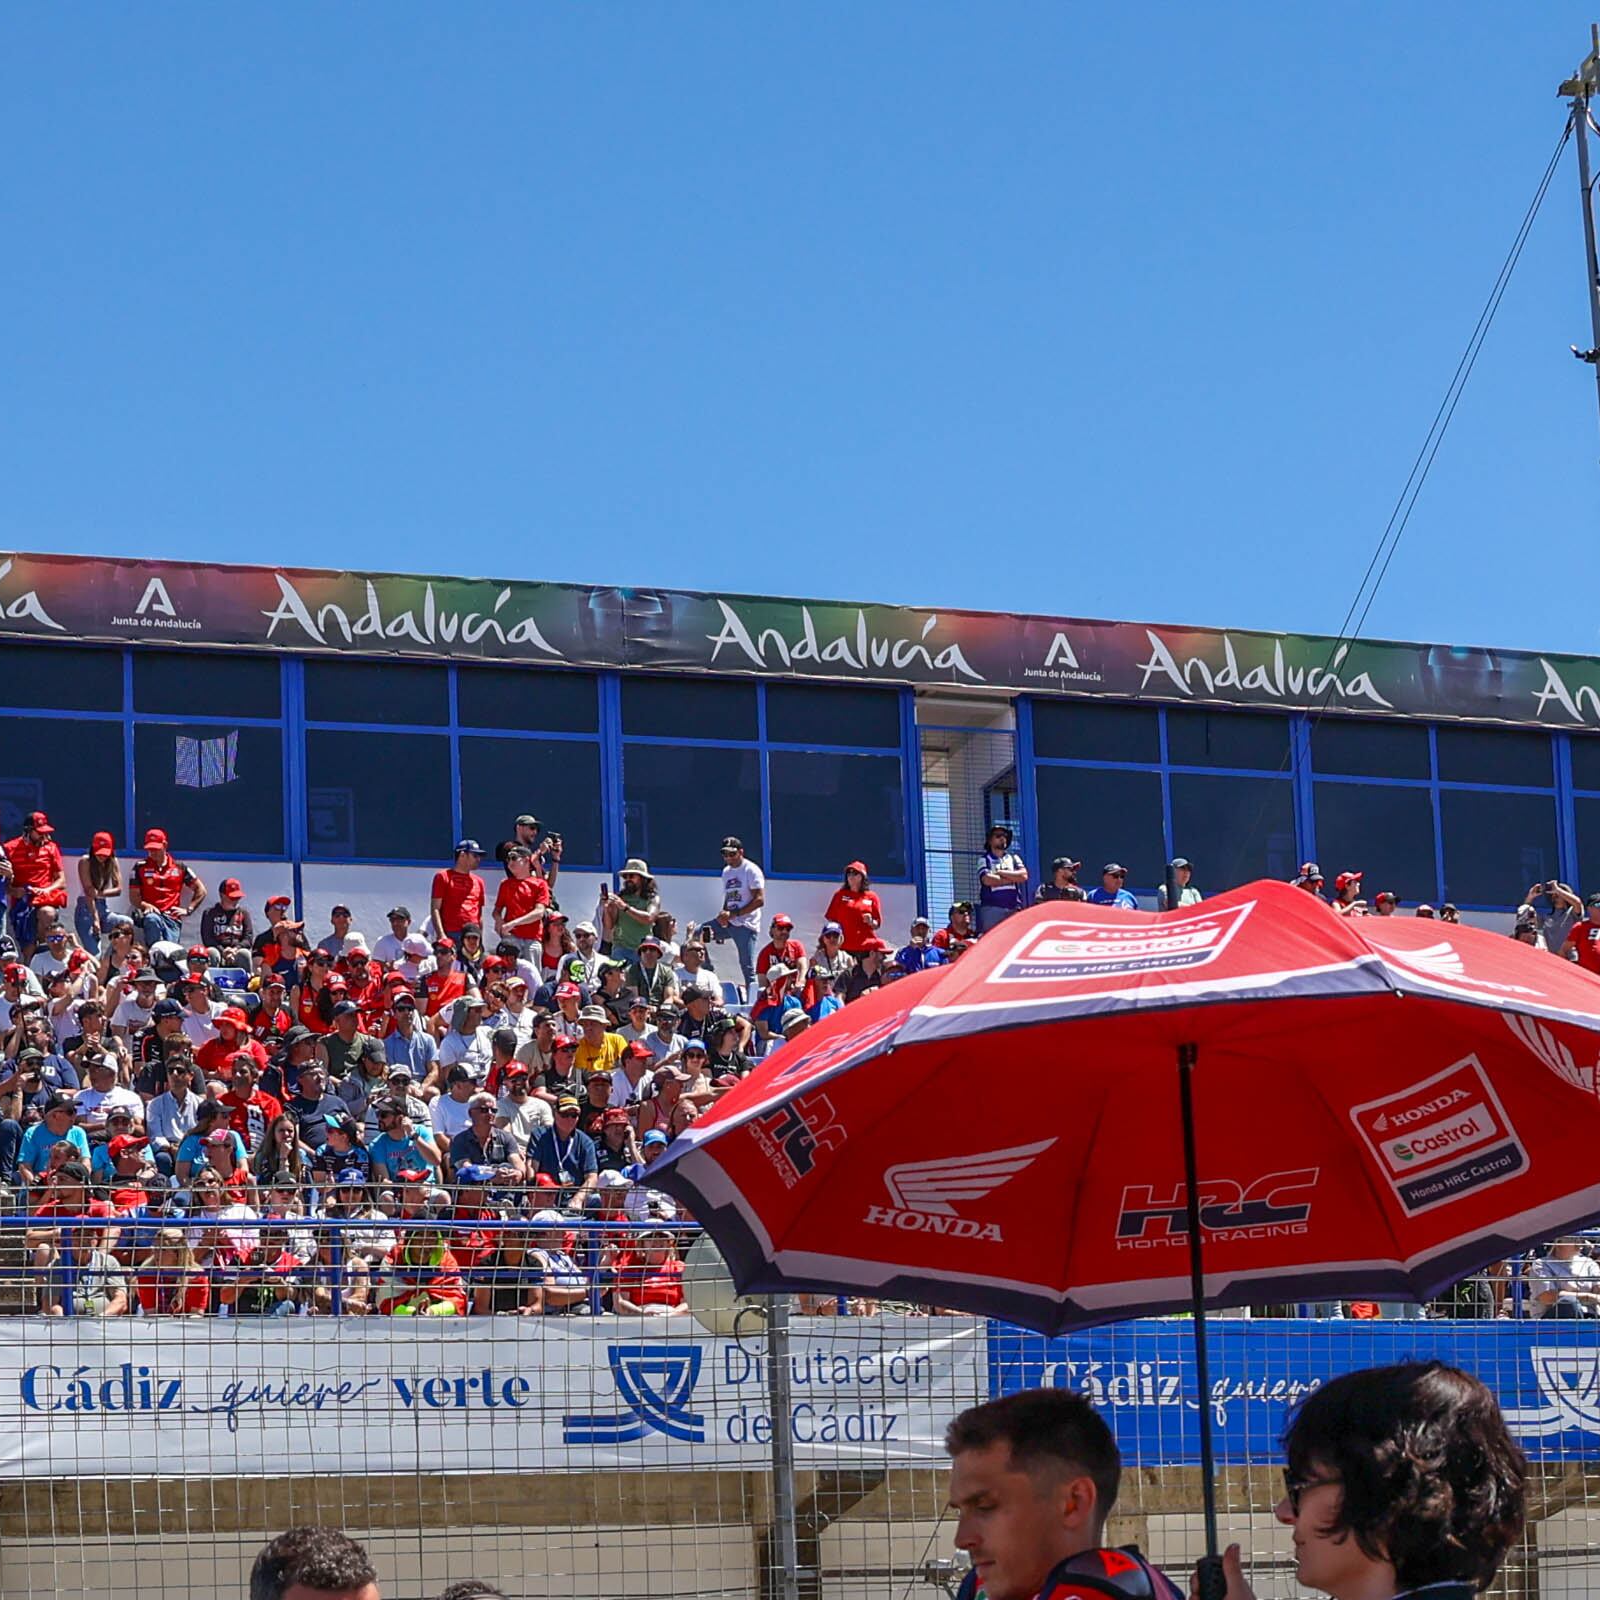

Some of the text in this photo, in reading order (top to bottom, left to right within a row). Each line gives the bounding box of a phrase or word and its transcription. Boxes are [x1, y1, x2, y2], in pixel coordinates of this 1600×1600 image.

[111, 616, 201, 630] Junta de Andalucía
[261, 572, 565, 656] Andalucía
[706, 600, 987, 681] Andalucía
[1023, 668, 1047, 678] Junta
[1138, 629, 1395, 708] Andalucía
[1094, 921, 1222, 940] HONDA
[1389, 1088, 1472, 1126] HONDA
[1410, 1117, 1480, 1155] Castrol
[1409, 1155, 1512, 1200] Honda HRC Castrol
[863, 1205, 1003, 1242] HONDA
[1212, 1223, 1308, 1243] RACING
[724, 1344, 932, 1386] Diutación
[20, 1363, 182, 1411] Cádiz
[392, 1368, 530, 1408] verte
[727, 1402, 898, 1444] de Cádiz
